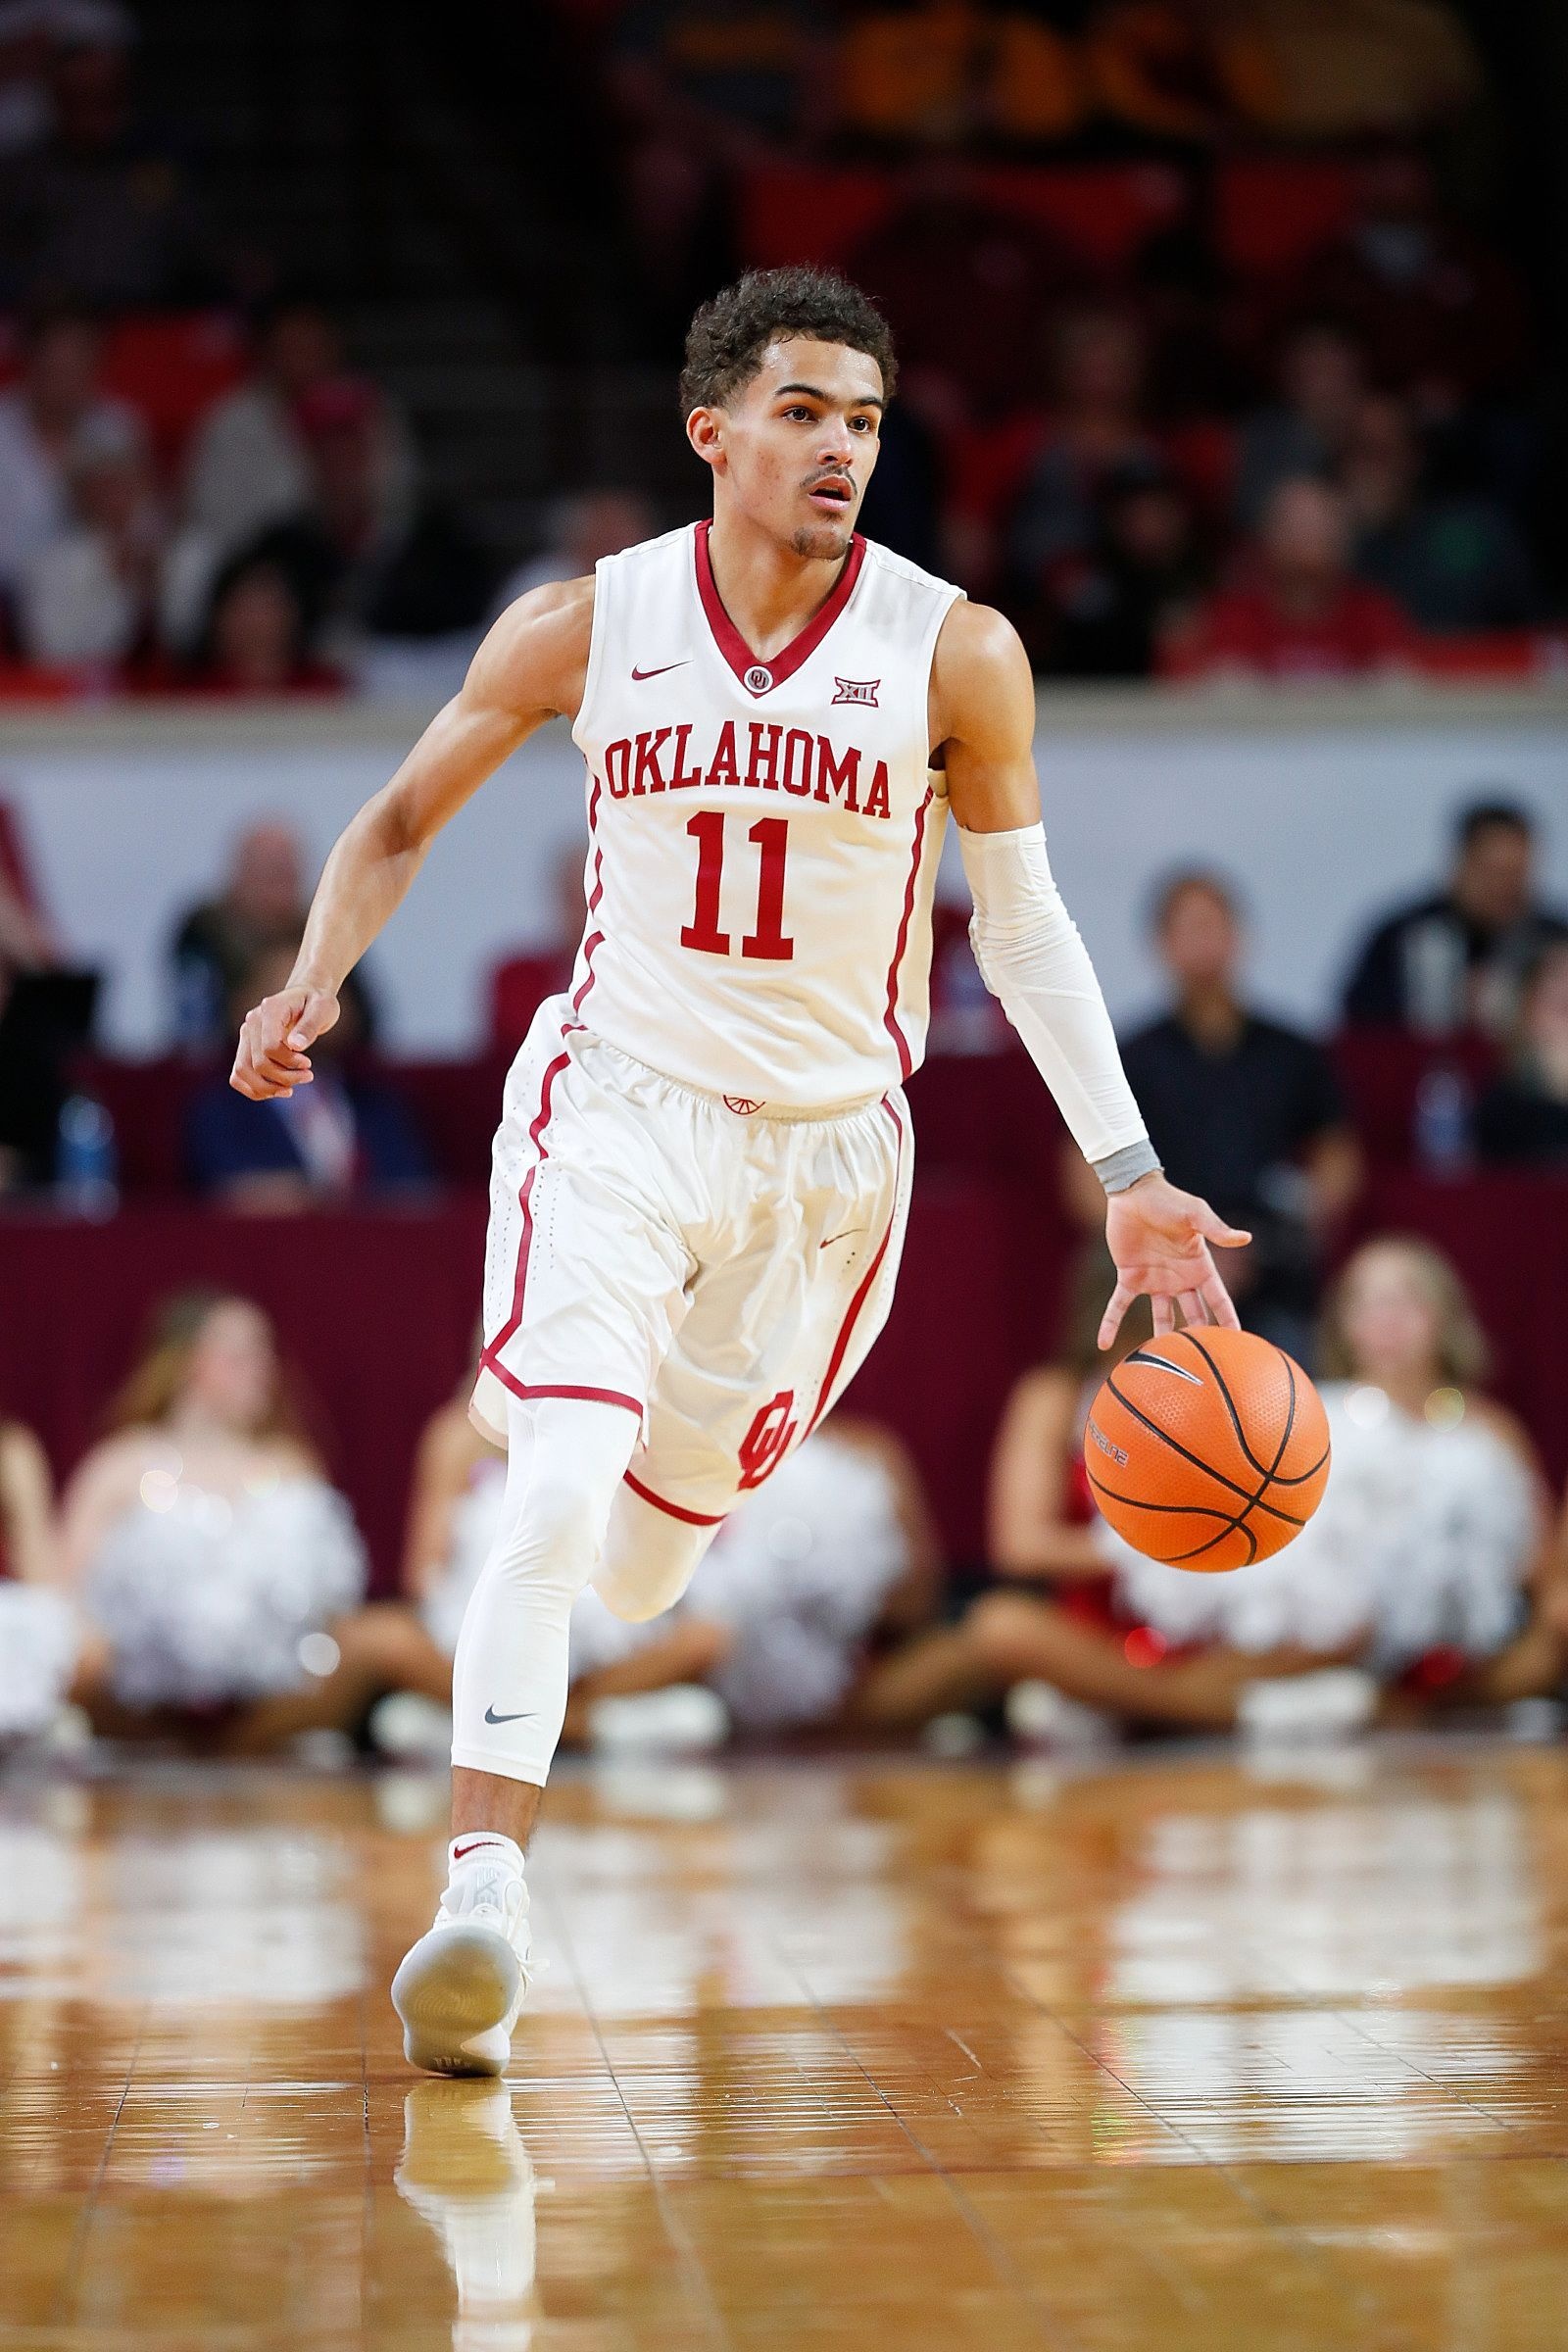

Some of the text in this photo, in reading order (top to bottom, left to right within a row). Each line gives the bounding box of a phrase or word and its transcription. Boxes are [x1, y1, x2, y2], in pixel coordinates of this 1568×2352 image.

[831, 676, 881, 708] XII
[605, 720, 892, 819] OKLAHOMA
[680, 810, 794, 961] 11
[736, 1389, 798, 1492] OU
